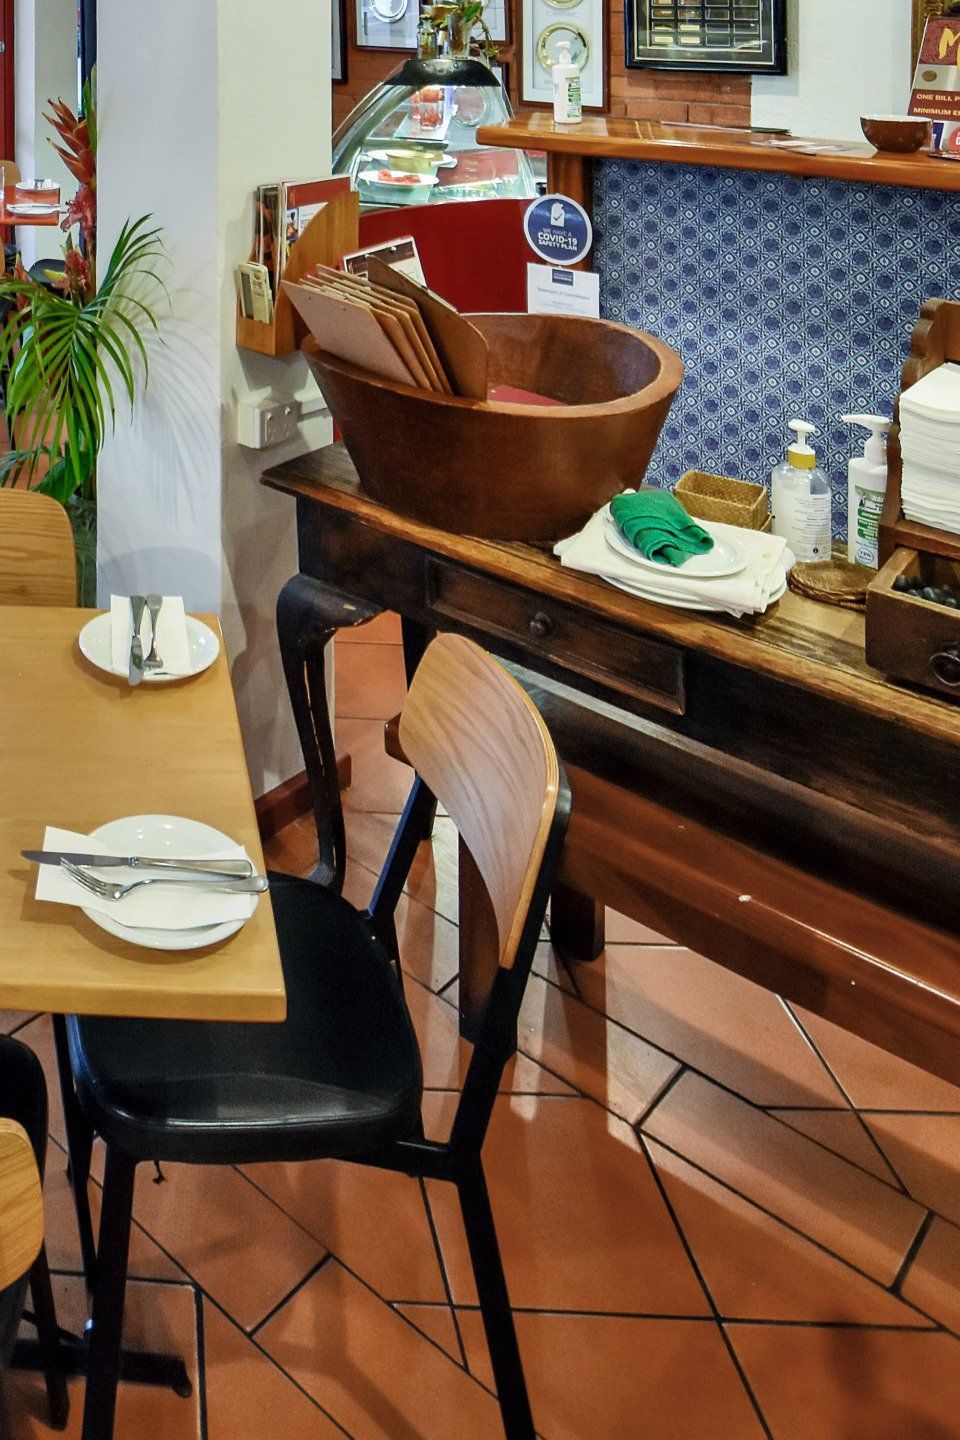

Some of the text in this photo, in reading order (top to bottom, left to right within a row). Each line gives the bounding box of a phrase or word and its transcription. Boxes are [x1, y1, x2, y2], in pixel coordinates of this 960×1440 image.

[916, 93, 934, 101] ONE
[935, 94, 953, 102] BILL
[913, 107, 951, 116] MINIMUM
[538, 232, 577, 246] COVID-19
[539, 240, 578, 251] SAFETY PLAN
